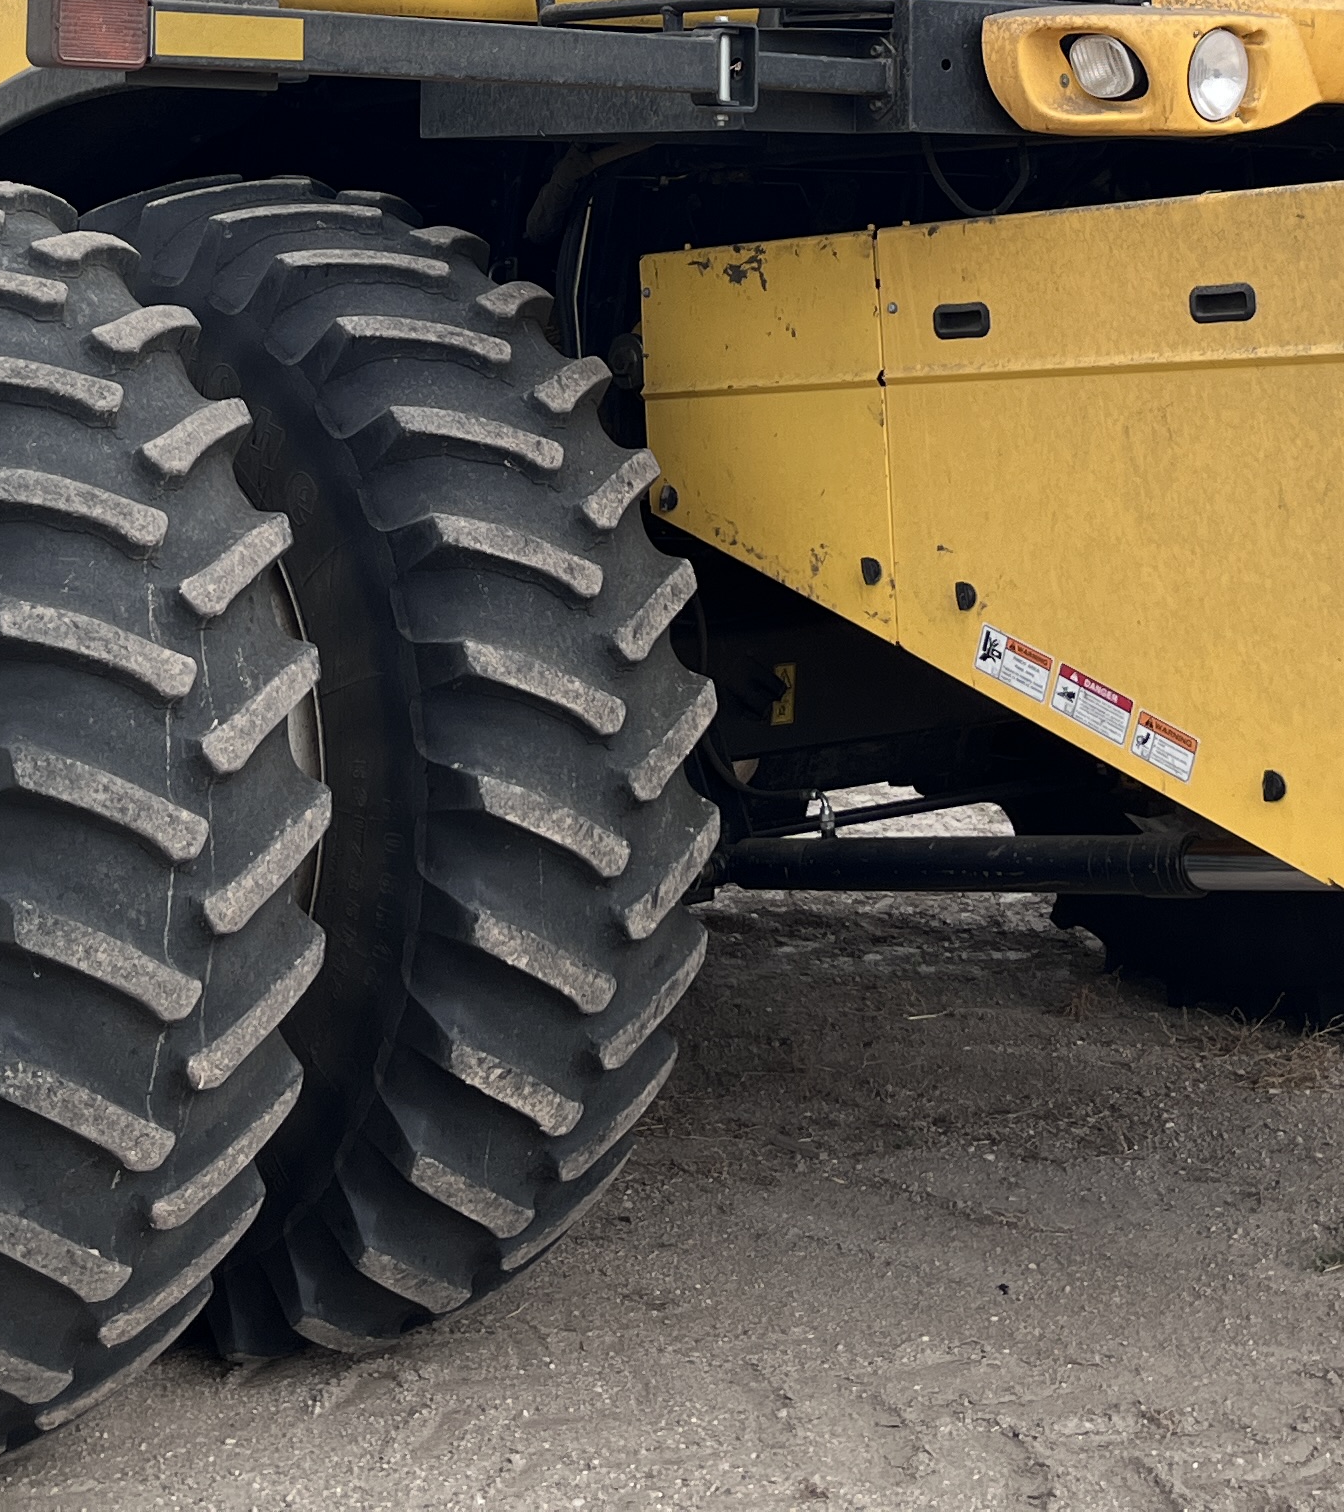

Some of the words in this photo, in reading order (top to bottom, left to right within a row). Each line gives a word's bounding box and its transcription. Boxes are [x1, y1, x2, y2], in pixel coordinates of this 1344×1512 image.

[1017, 645, 1048, 666] WARNING
[1083, 678, 1119, 704] DANGER
[1155, 721, 1193, 748] WARNING
